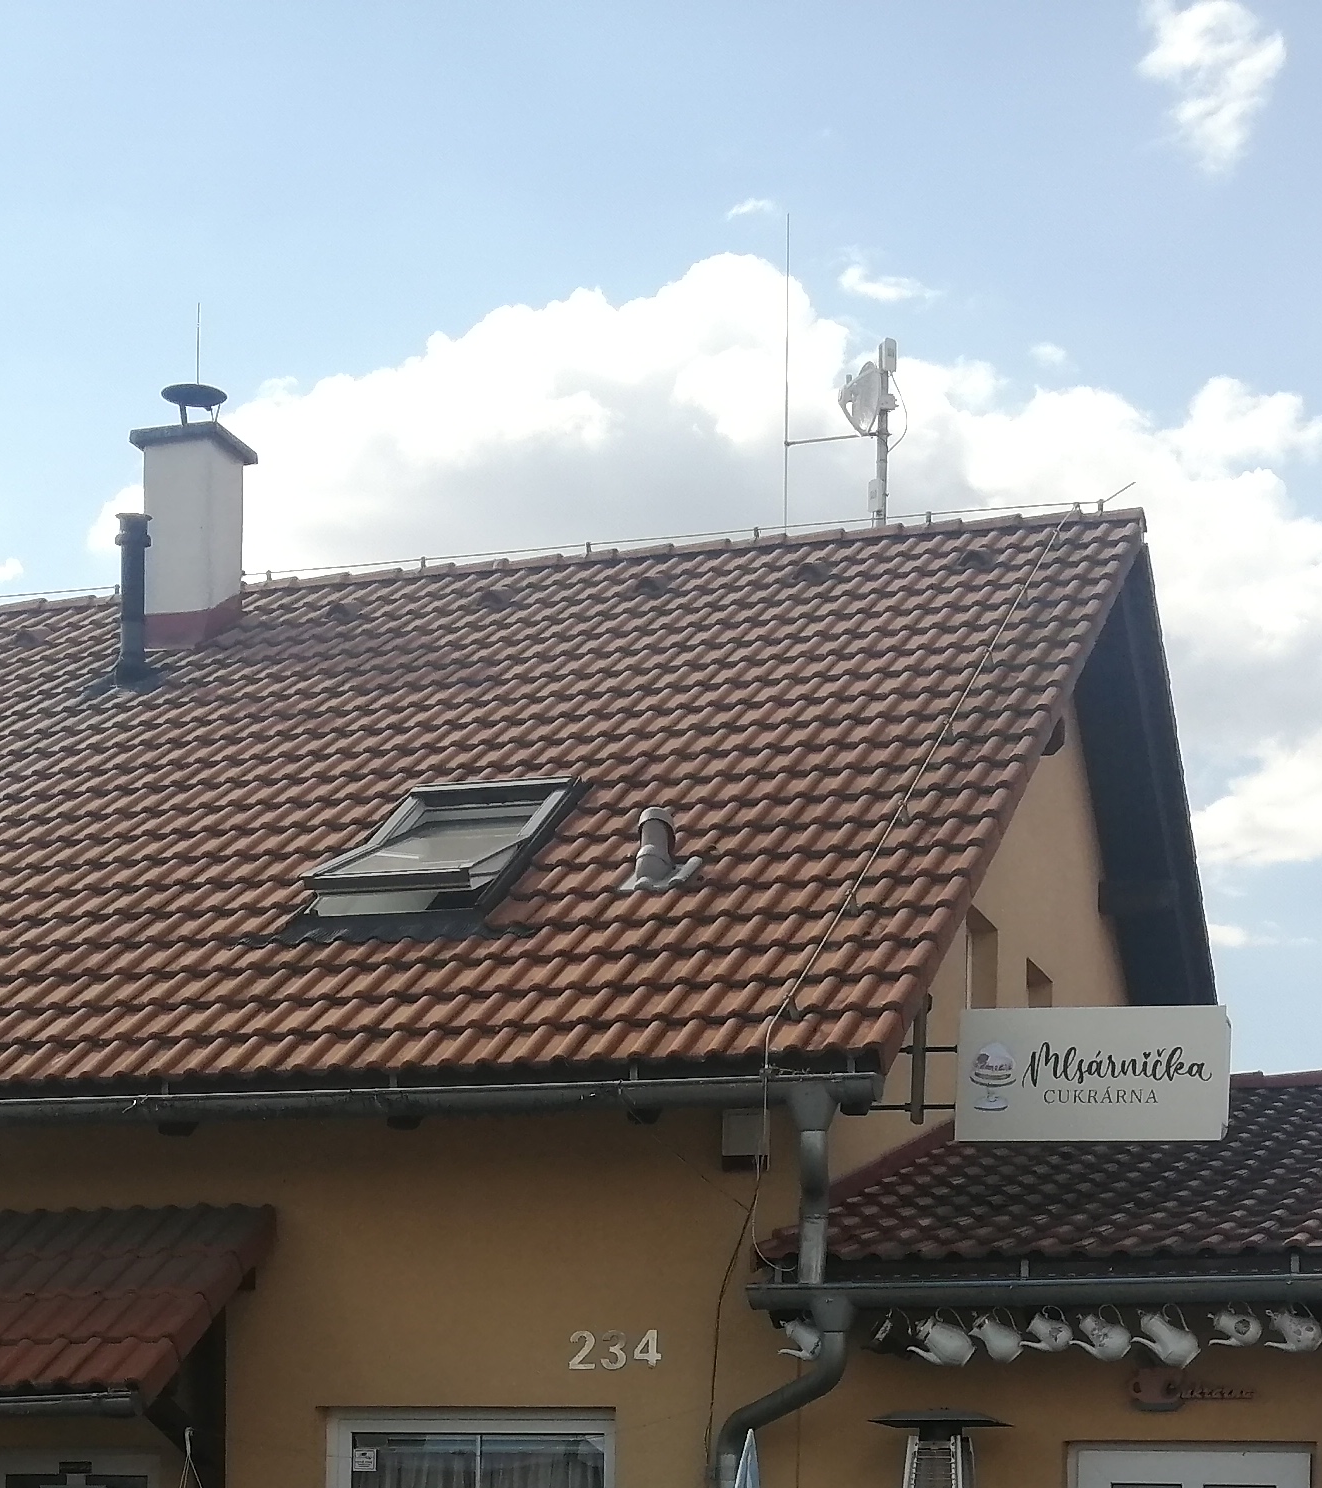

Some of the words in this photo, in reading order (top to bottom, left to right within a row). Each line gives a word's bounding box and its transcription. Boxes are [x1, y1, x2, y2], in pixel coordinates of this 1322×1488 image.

[1021, 1041, 1213, 1088] Mlsárnička
[1043, 1086, 1159, 1105] CUKRÁRNA
[568, 1329, 662, 1370] 234
